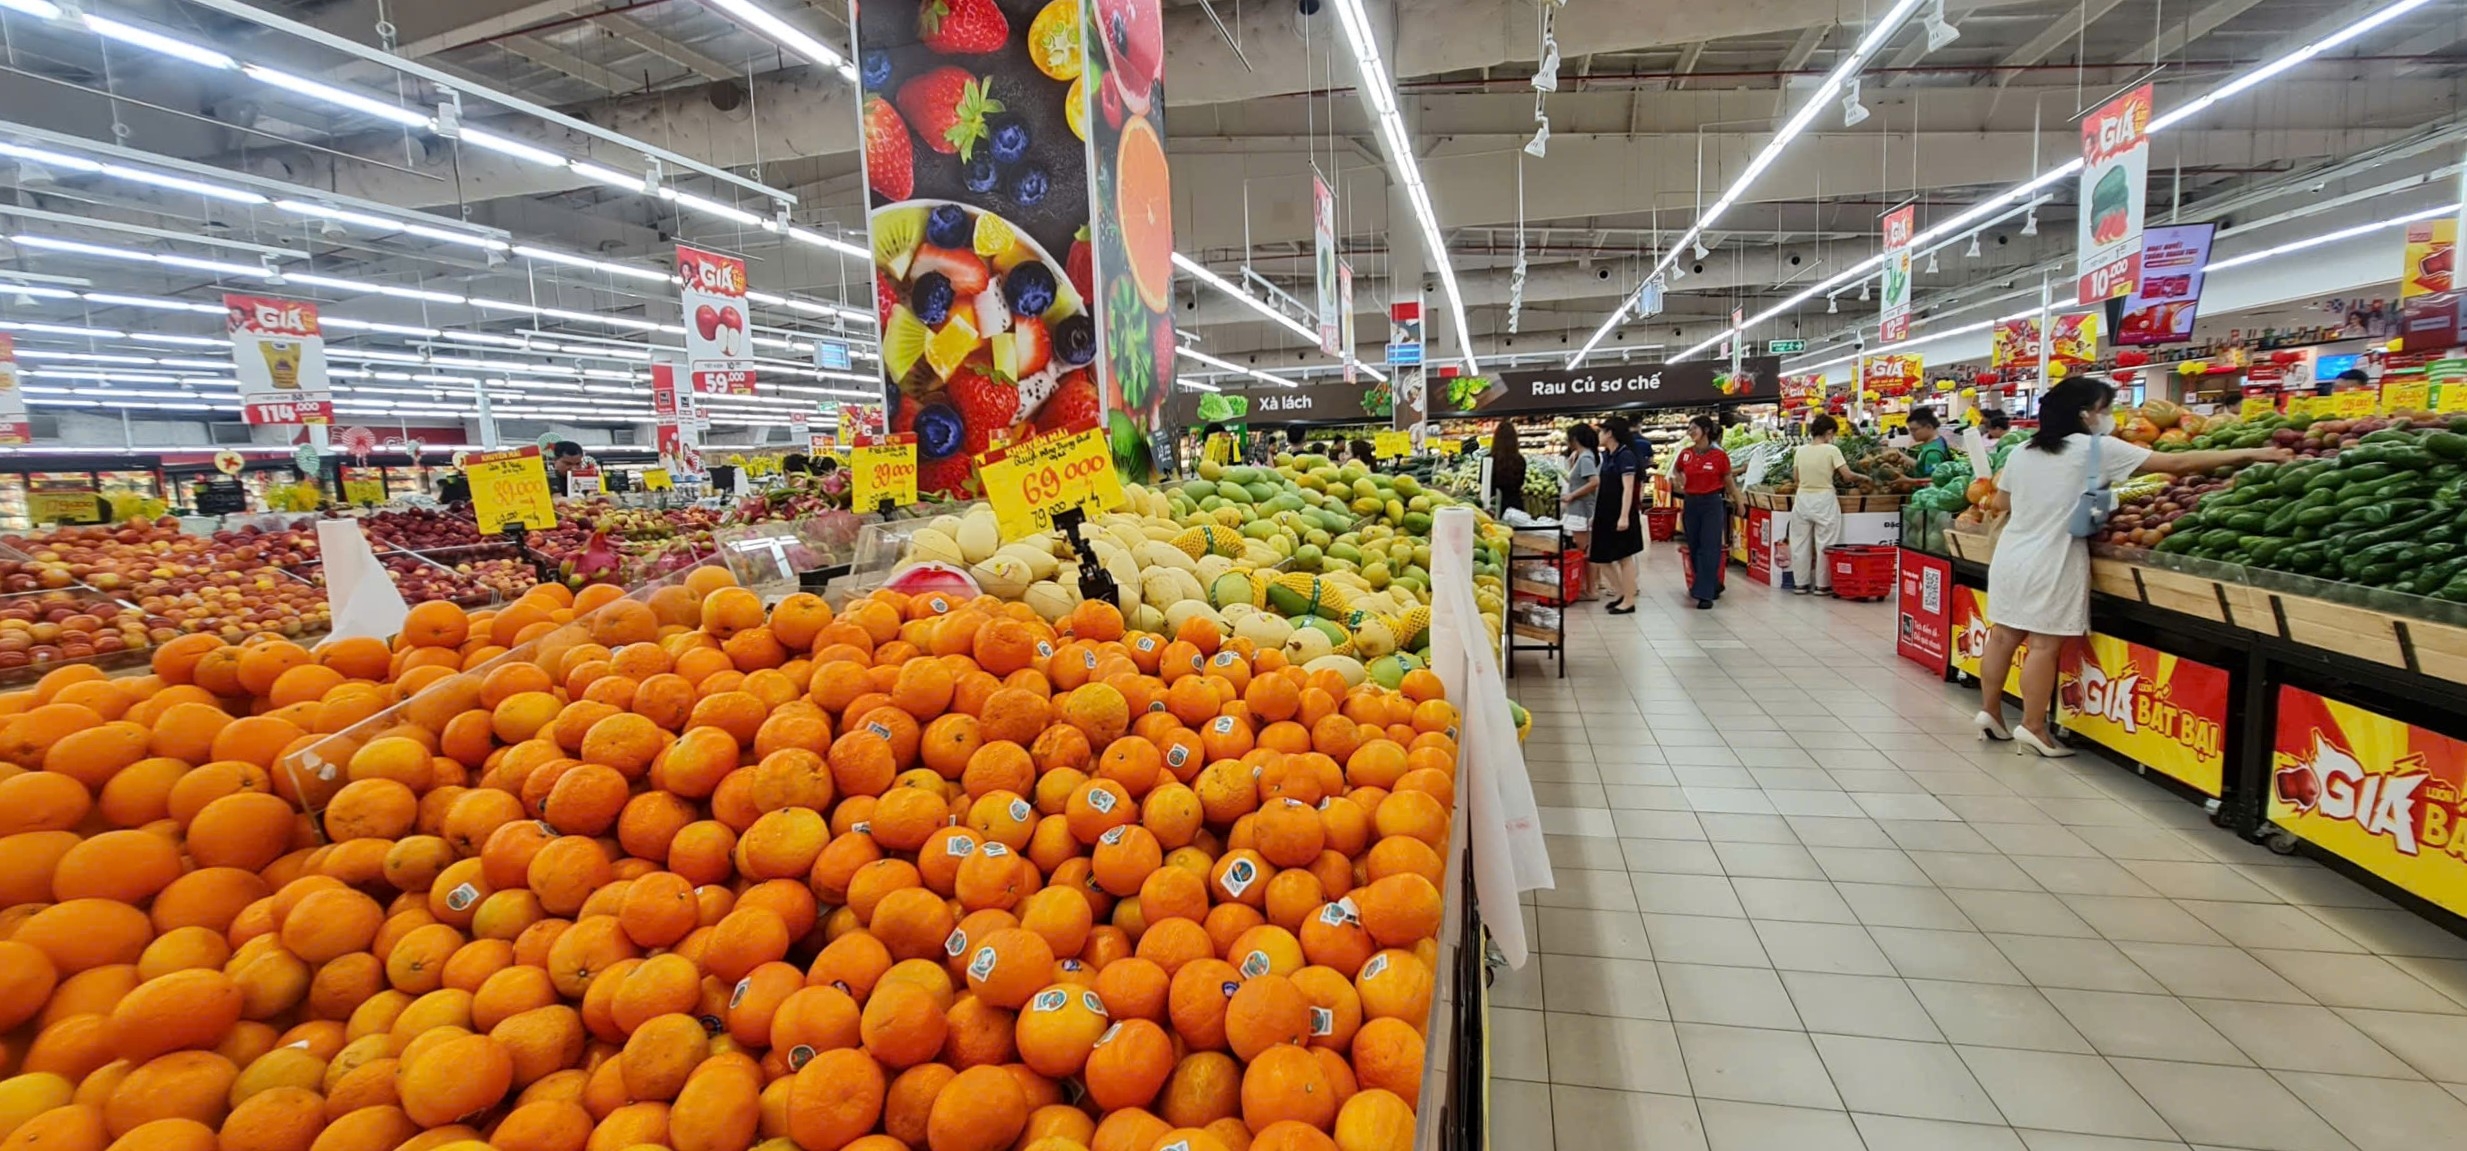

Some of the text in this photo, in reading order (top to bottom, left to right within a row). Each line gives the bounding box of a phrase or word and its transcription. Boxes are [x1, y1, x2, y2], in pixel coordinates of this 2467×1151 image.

[2101, 99, 2137, 152] GIÁ
[699, 257, 735, 292] GIÁ
[254, 302, 306, 331] GIÁ
[1532, 371, 1662, 396] Rau Củ sơ chế
[1872, 356, 1906, 378] GIÁ
[1282, 394, 1312, 410] lách
[2080, 657, 2141, 733] GIÁ
[2137, 684, 2218, 762] BẤT BẠI
[2313, 733, 2429, 855] GIÁ
